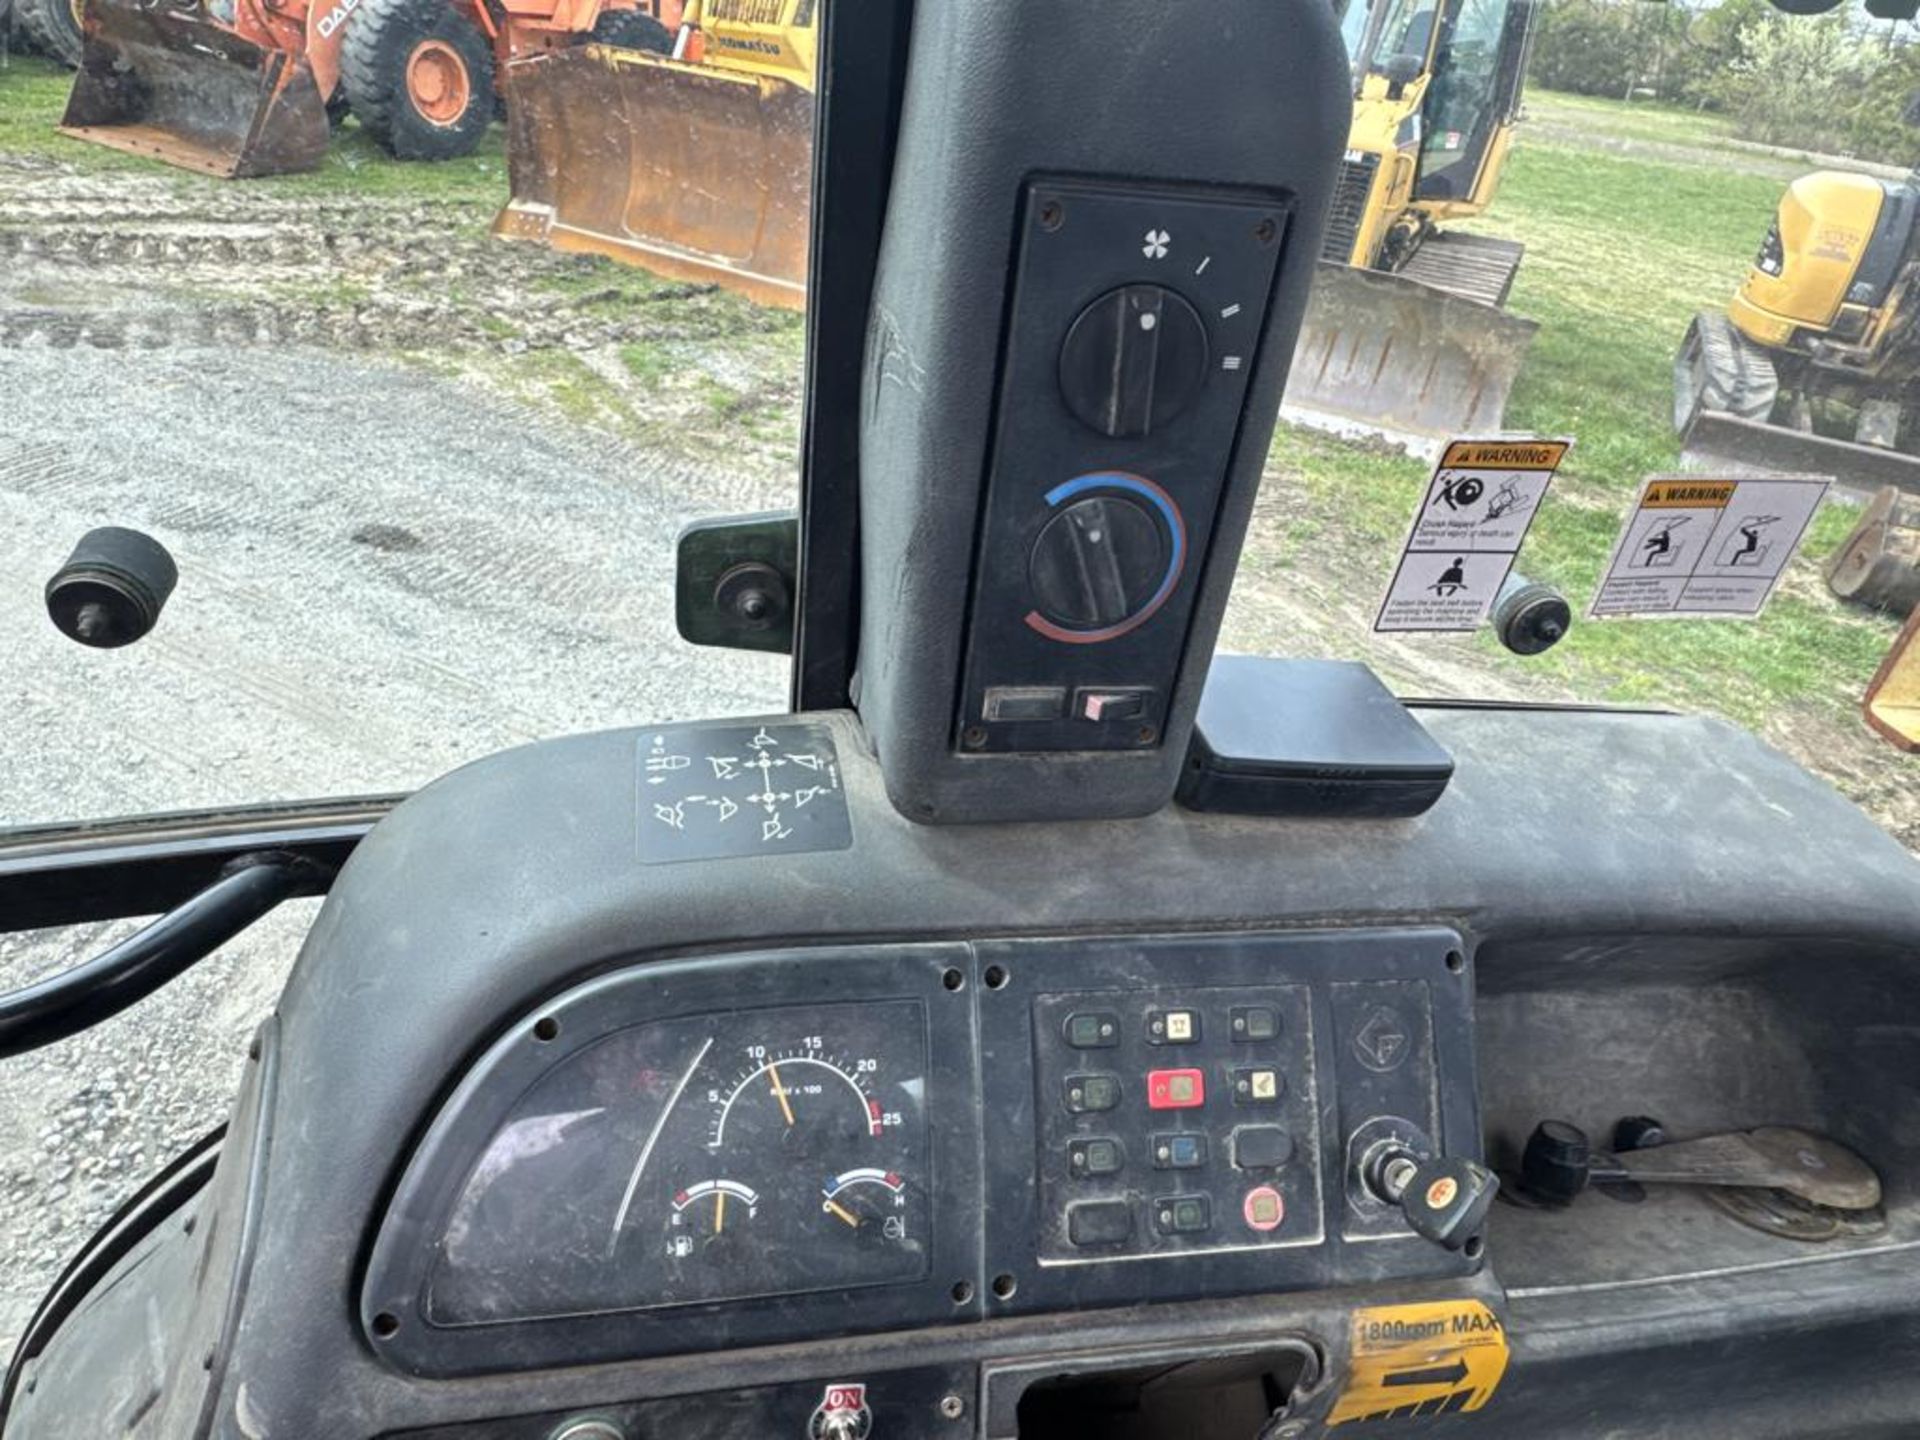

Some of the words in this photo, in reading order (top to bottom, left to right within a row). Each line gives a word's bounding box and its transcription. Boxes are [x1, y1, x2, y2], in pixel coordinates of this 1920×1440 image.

[1476, 449, 1551, 464] WARNING
[1666, 487, 1730, 501] WARNING
[803, 1036, 822, 1049] 15
[747, 1046, 765, 1059] 10
[857, 1059, 877, 1072] 20
[803, 1084, 822, 1095] 100
[708, 1090, 719, 1103] 5
[882, 1112, 902, 1126] 25
[749, 1206, 758, 1218] F
[672, 1213, 682, 1225] E
[1451, 1313, 1500, 1333] MAX
[830, 1390, 858, 1408] ON
